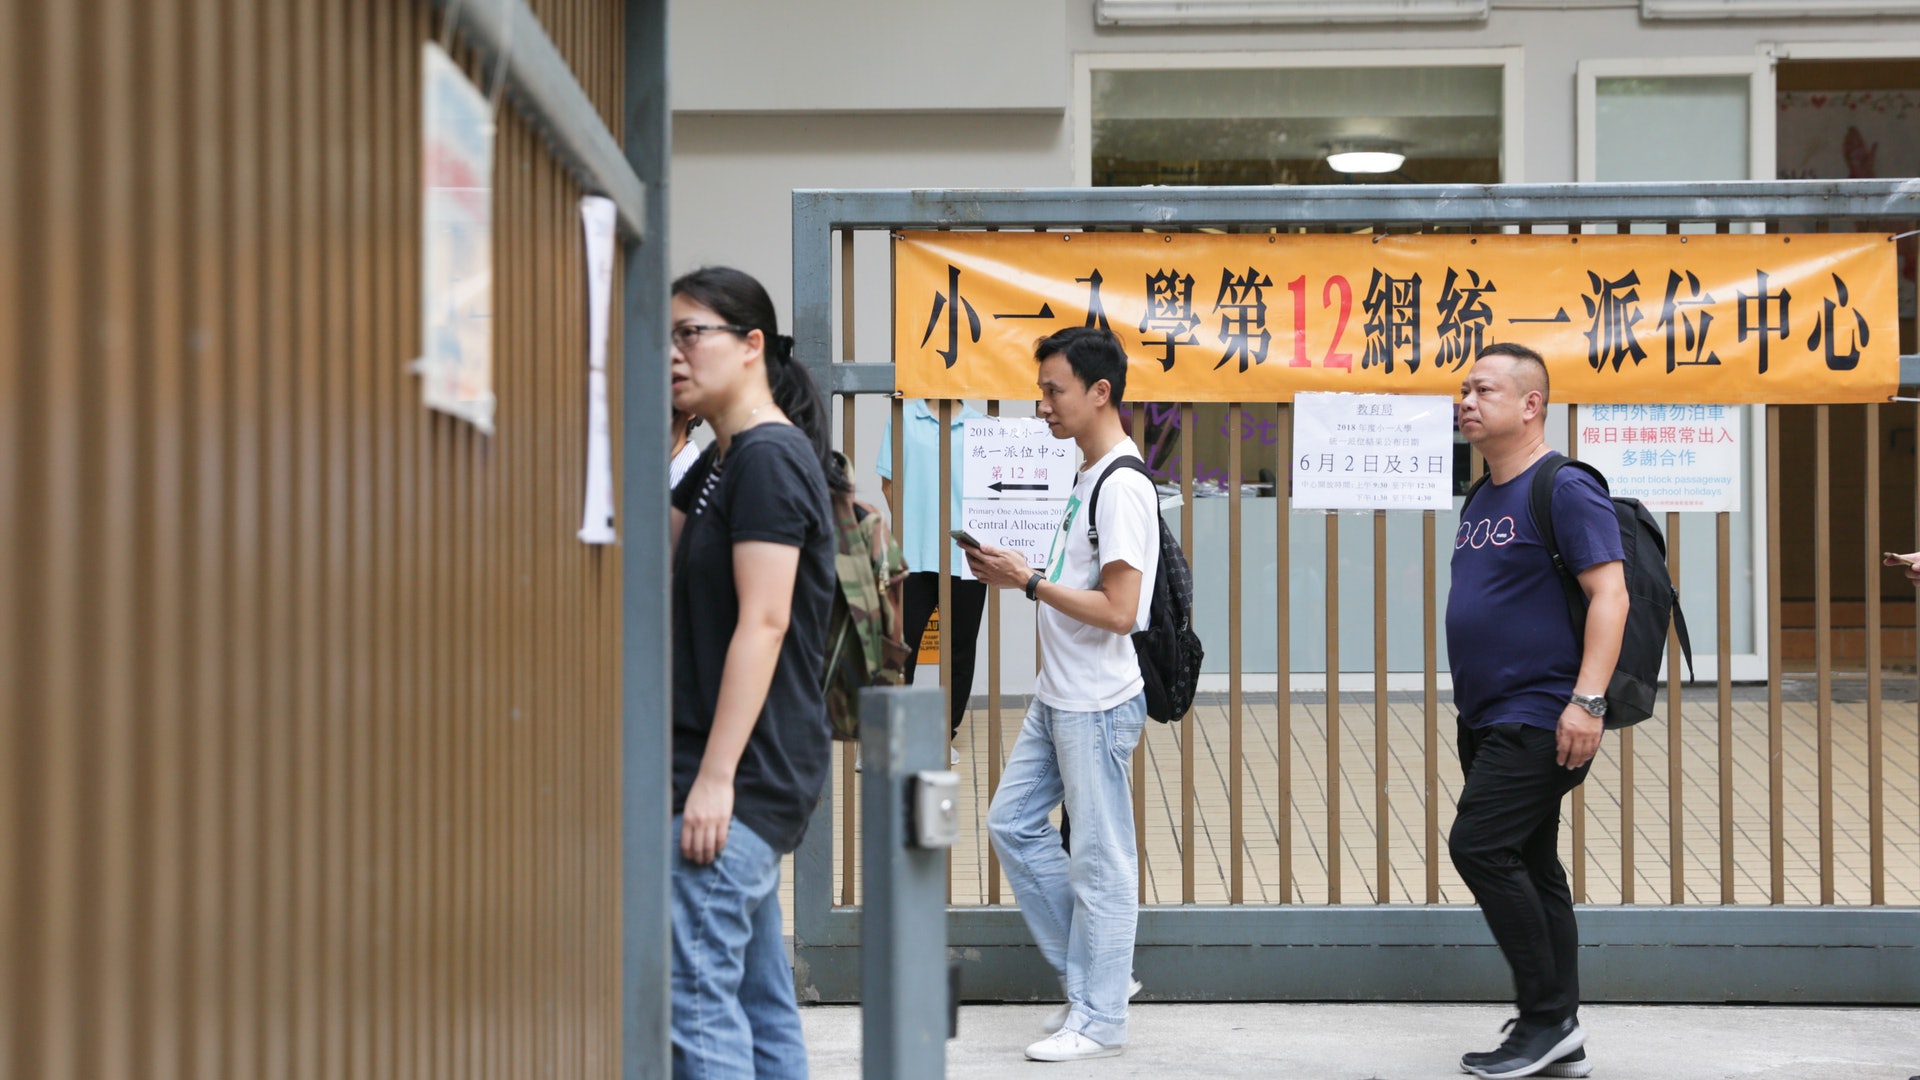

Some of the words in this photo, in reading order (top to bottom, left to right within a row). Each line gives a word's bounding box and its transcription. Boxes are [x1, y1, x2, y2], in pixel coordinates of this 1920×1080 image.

[1592, 404, 1725, 421] 校門外請勿泊車
[969, 428, 994, 437] 2018
[1583, 426, 1734, 444] 假日車輛照常出入
[972, 445, 1066, 459] 統一派位中心
[1622, 449, 1696, 467] 多謝合作
[1011, 467, 1024, 479] 12
[1617, 475, 1629, 484] do
[1631, 475, 1646, 484] not
[1648, 474, 1672, 484] block
[1675, 476, 1732, 486] passageway
[1620, 487, 1650, 497] during
[1652, 487, 1682, 496] school
[1684, 487, 1722, 497] holidays
[969, 508, 995, 516] Primary
[968, 519, 1008, 530] Central
[1011, 520, 1059, 531] Allocatio
[1000, 536, 1036, 547] Centre
